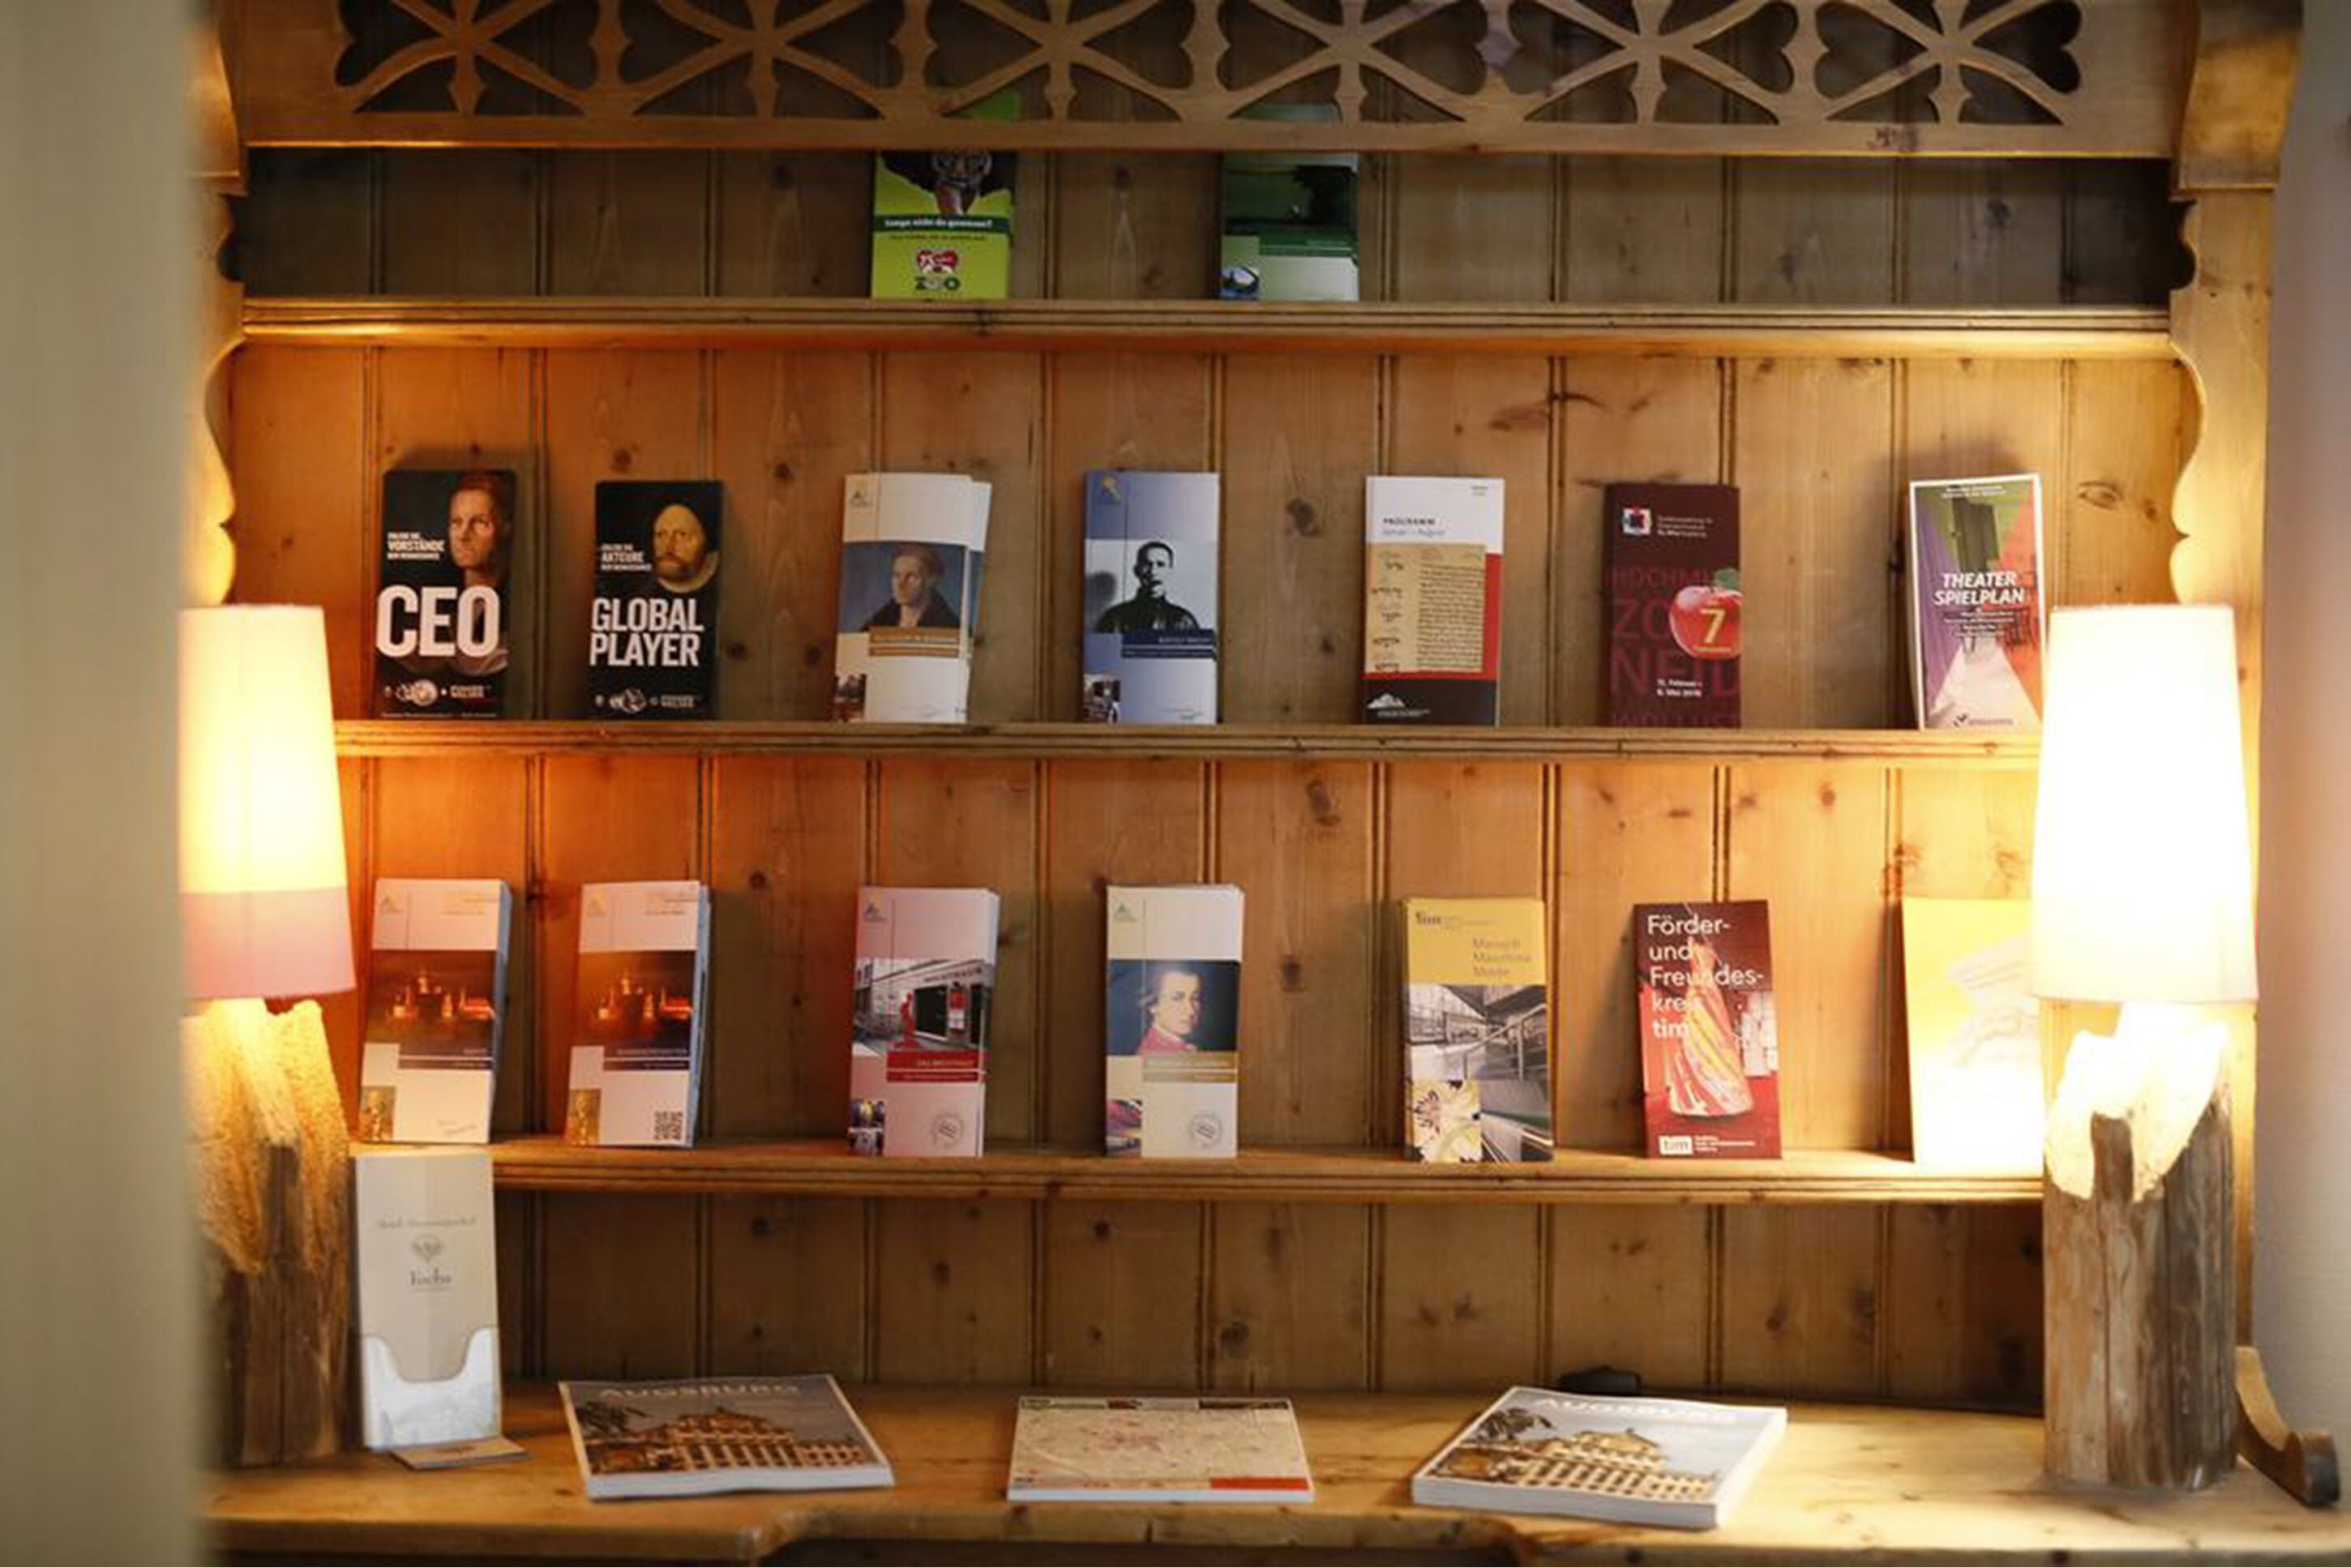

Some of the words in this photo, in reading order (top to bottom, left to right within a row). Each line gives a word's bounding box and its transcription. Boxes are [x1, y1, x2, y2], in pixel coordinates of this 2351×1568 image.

[1382, 516, 1436, 526] PROGRAMM
[1942, 572, 2017, 589] THEATER
[1933, 589, 2025, 606] SPIELPLAN
[375, 584, 500, 658] CEO
[590, 597, 704, 632] GLOBAL
[1699, 608, 1727, 644] 7
[589, 632, 700, 667] PLAYER
[1647, 913, 1731, 935] Förder-
[1648, 936, 1694, 961] und
[1651, 1017, 1689, 1039] tim
[1663, 1137, 1690, 1151] tim
[598, 1384, 800, 1399] AUGSBURG
